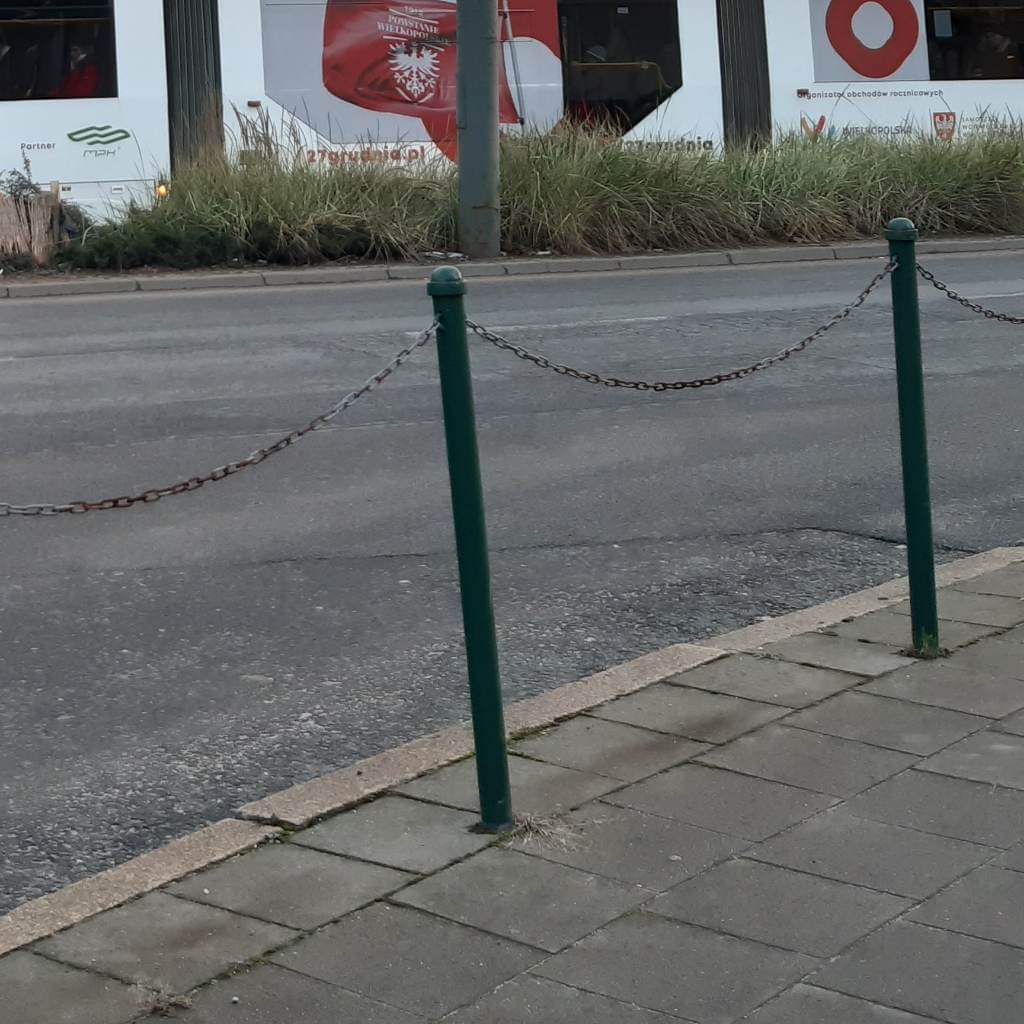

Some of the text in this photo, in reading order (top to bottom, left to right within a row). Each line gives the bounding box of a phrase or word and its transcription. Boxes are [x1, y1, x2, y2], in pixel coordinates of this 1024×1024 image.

[387, 14, 440, 35] POWSTANIE
[847, 90, 888, 99] obchodów
[890, 89, 944, 99] rocznicowych
[20, 142, 56, 151] Partner
